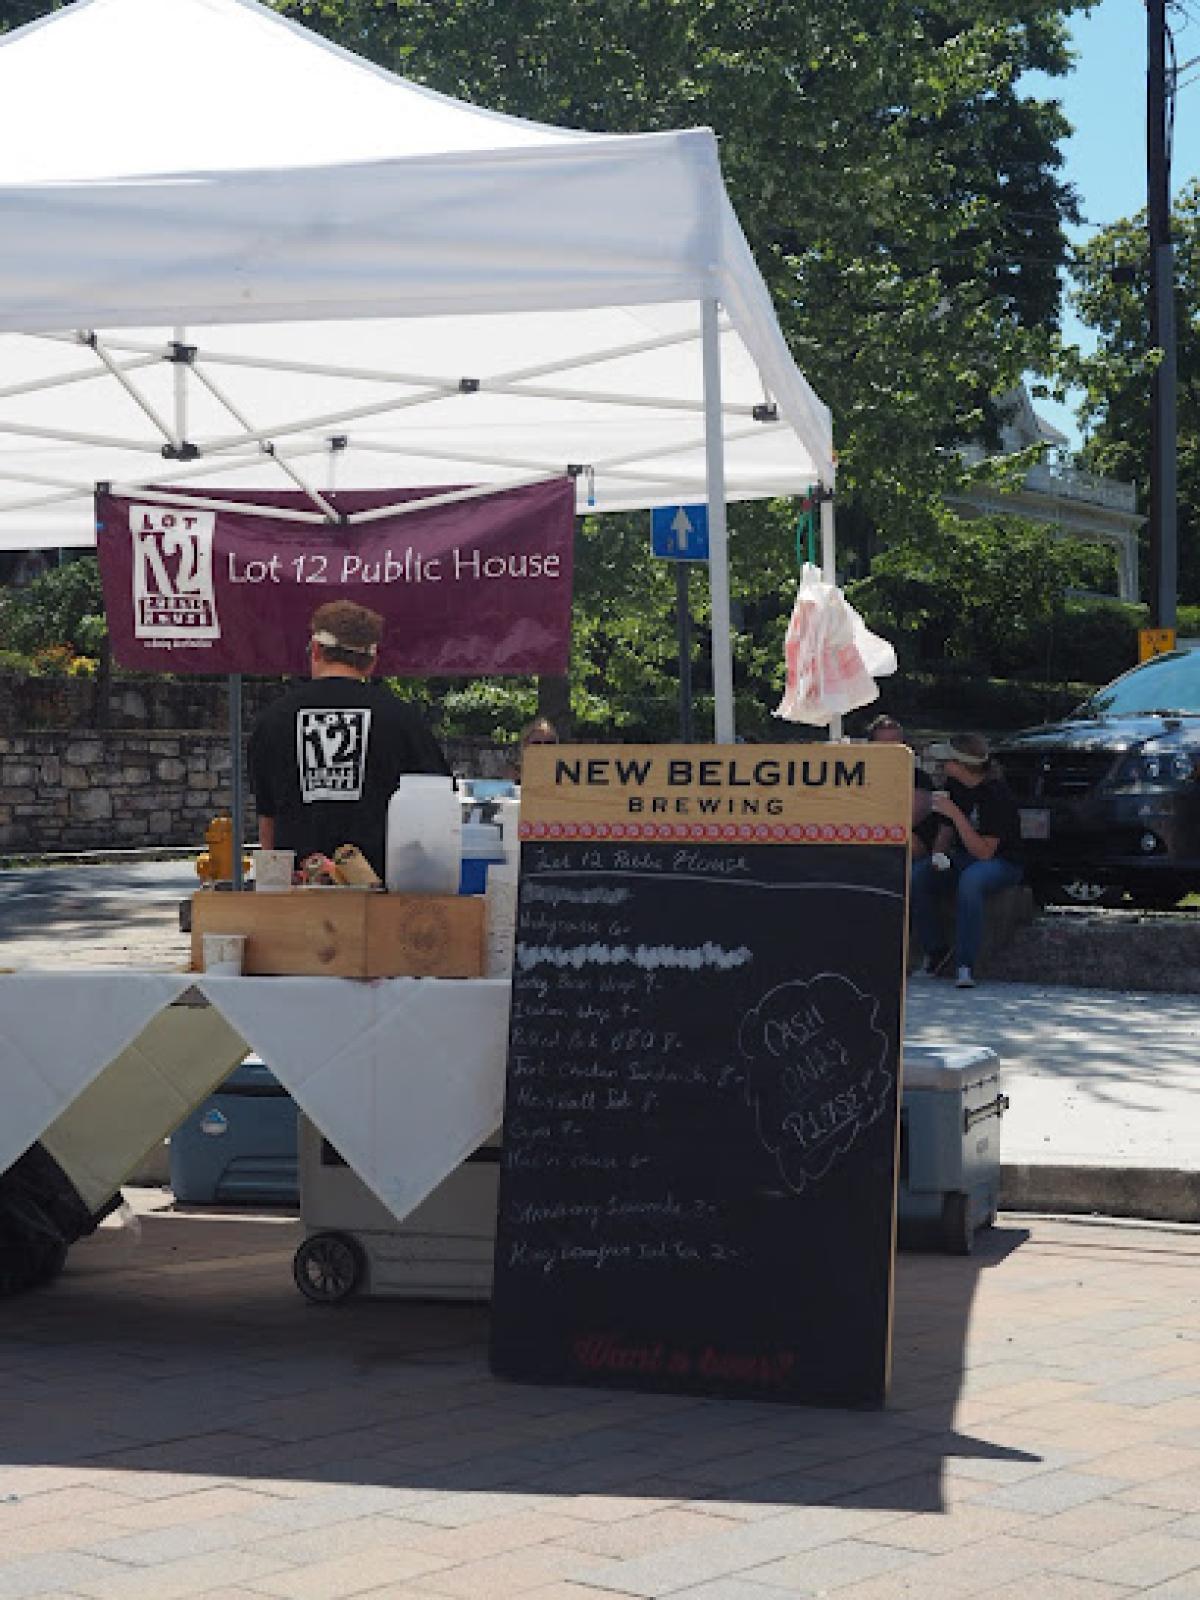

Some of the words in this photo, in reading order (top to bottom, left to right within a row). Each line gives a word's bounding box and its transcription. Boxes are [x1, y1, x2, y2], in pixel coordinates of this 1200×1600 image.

[143, 514, 197, 530] LOT
[228, 552, 282, 583] Lot
[292, 554, 328, 582] 12
[340, 547, 441, 583] Public
[453, 548, 561, 580] House
[310, 713, 356, 727] LOT
[555, 760, 653, 785] NEW
[668, 761, 865, 786] BELGIUM
[628, 797, 784, 815] BREWING
